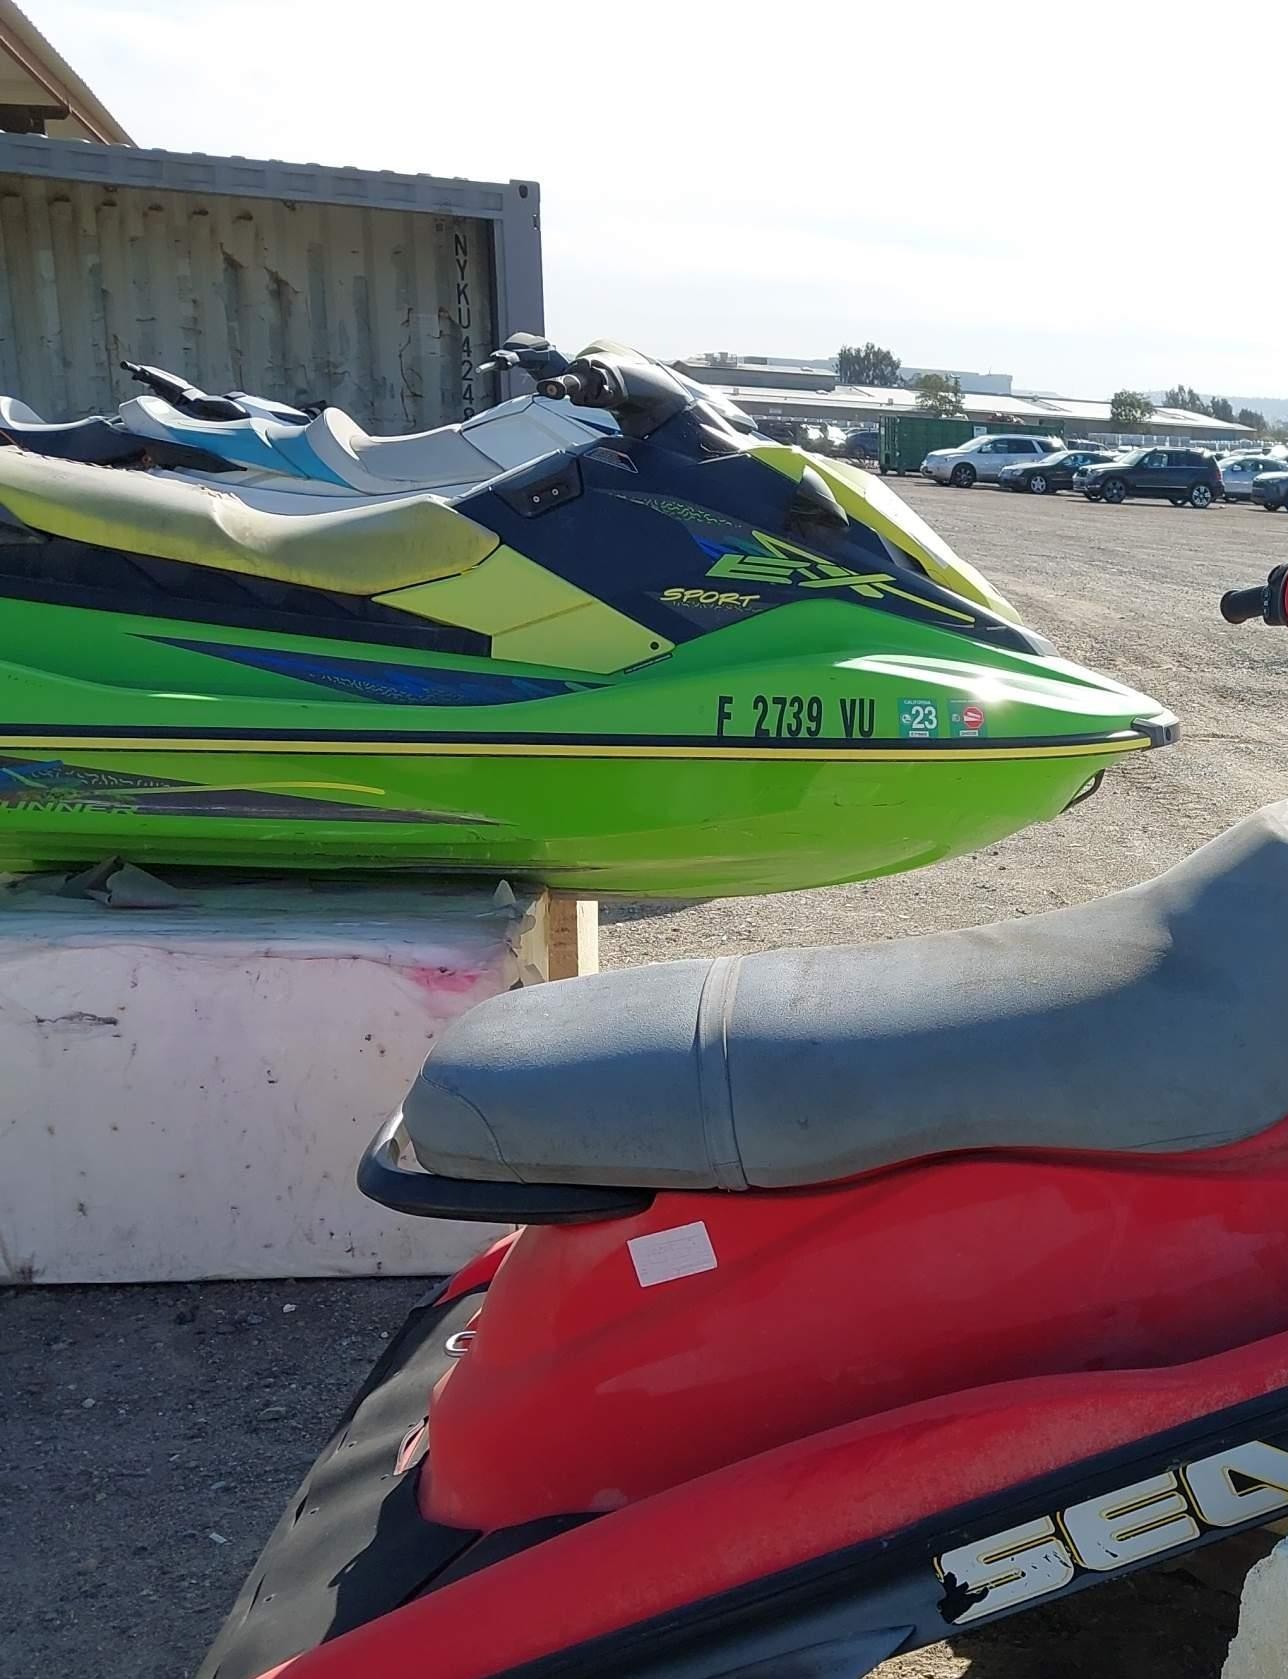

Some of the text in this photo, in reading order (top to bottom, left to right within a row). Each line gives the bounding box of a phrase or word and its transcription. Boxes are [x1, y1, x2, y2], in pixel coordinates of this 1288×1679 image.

[454, 233, 471, 329] NYKU
[659, 588, 760, 607] SPORT
[717, 695, 875, 737] F 2739 VU
[911, 706, 937, 729] 23
